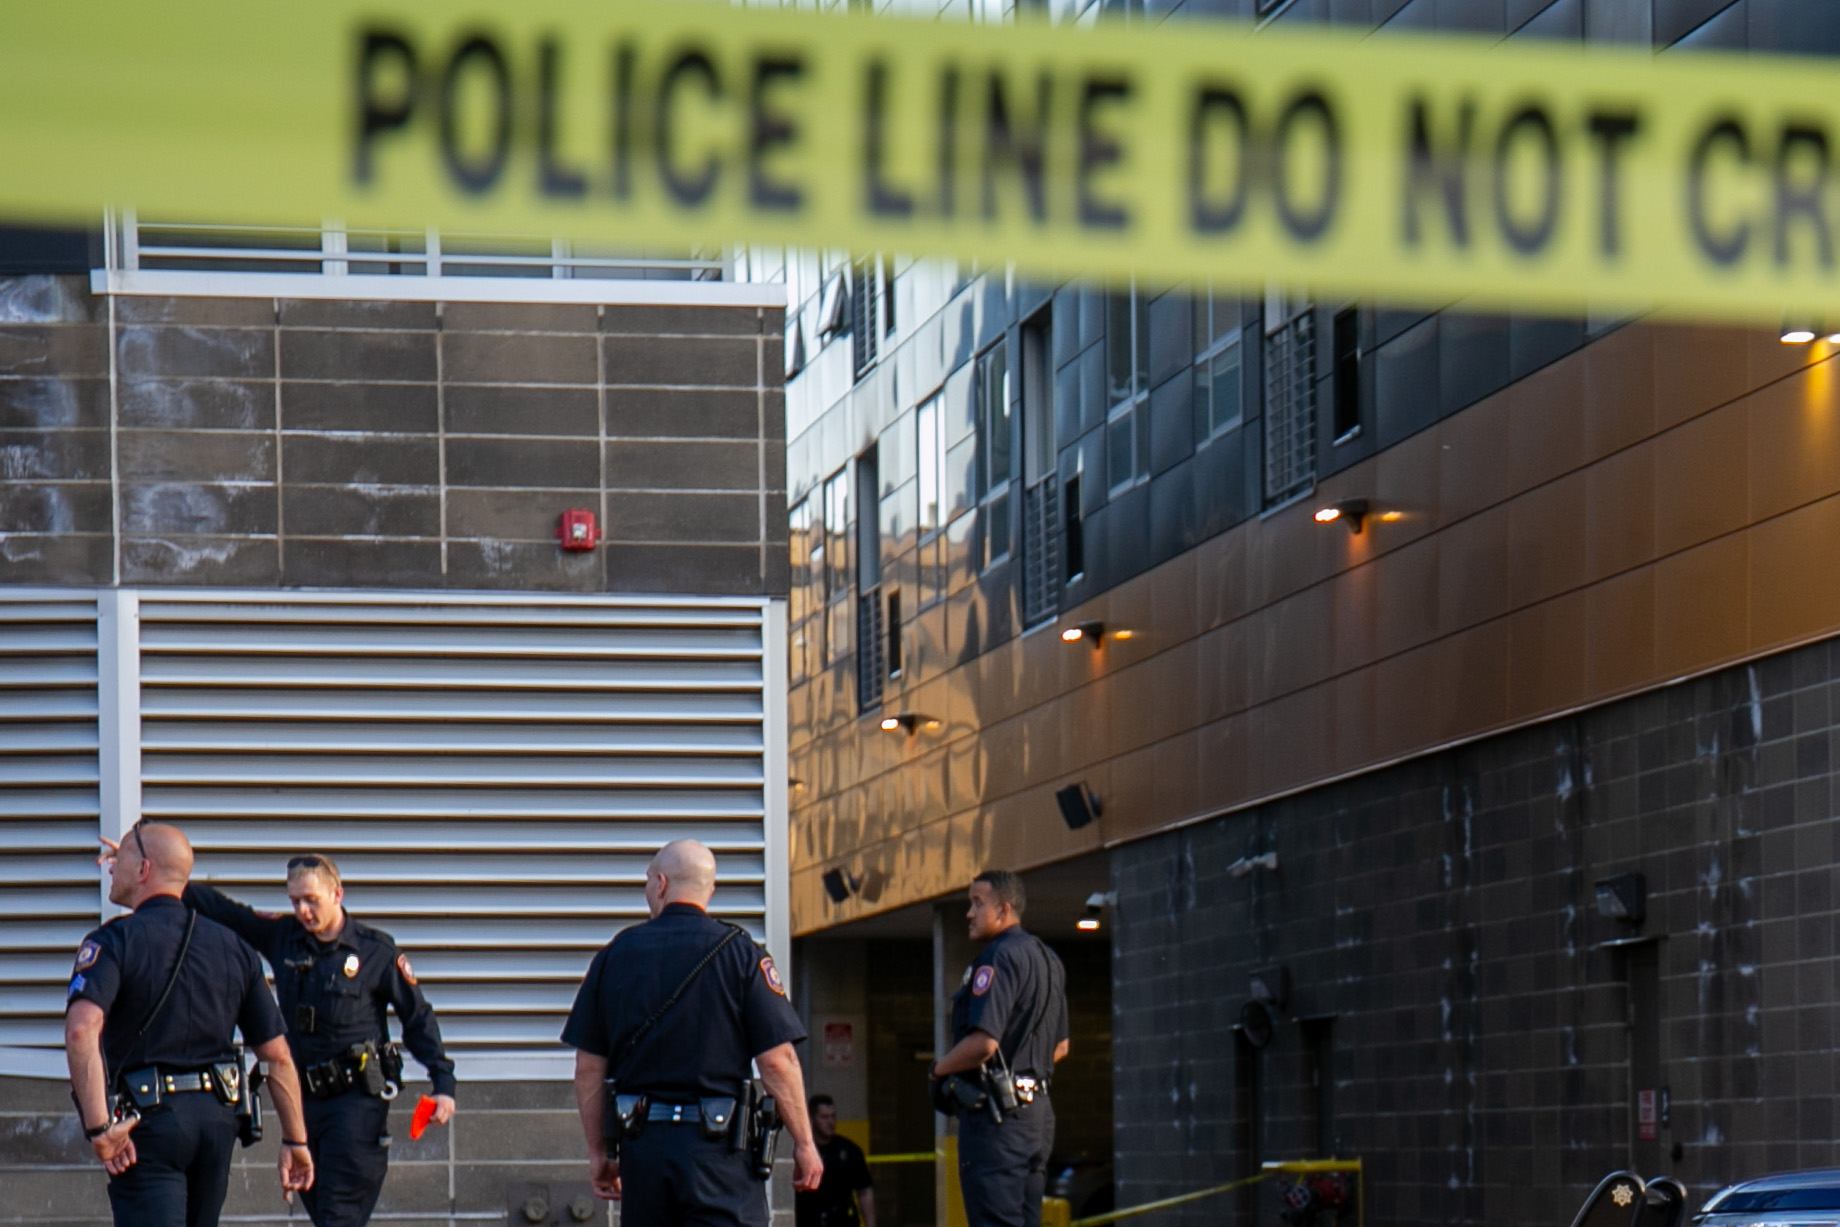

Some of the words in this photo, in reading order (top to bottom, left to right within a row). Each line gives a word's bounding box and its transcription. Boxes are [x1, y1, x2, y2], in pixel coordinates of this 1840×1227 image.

[352, 23, 808, 212] POLICE
[864, 60, 1136, 231] LINE
[1187, 80, 1344, 245] DO
[1402, 96, 1648, 258] NOT
